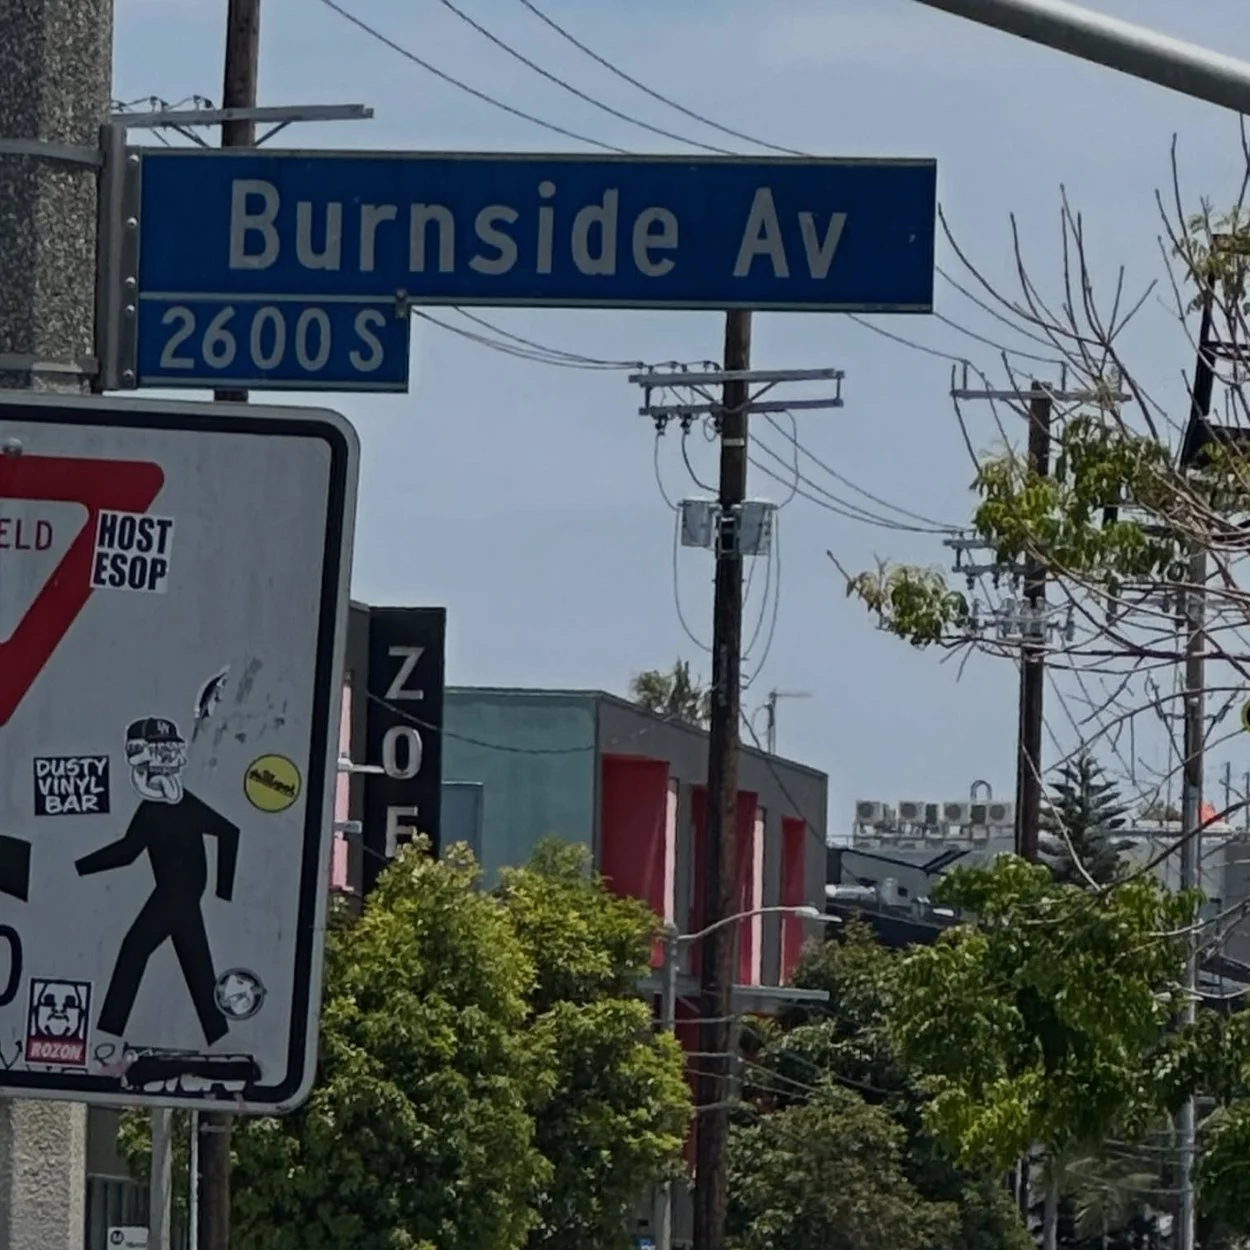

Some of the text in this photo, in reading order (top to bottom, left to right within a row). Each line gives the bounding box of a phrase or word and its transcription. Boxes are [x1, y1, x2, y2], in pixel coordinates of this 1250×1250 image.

[229, 179, 848, 280] Burnside Av
[159, 304, 387, 372] 2600 S
[97, 513, 173, 554] HOST
[92, 551, 168, 591] ESOP
[36, 757, 107, 777] DUSTY
[38, 775, 105, 796] VINYL
[45, 794, 100, 814] BAR
